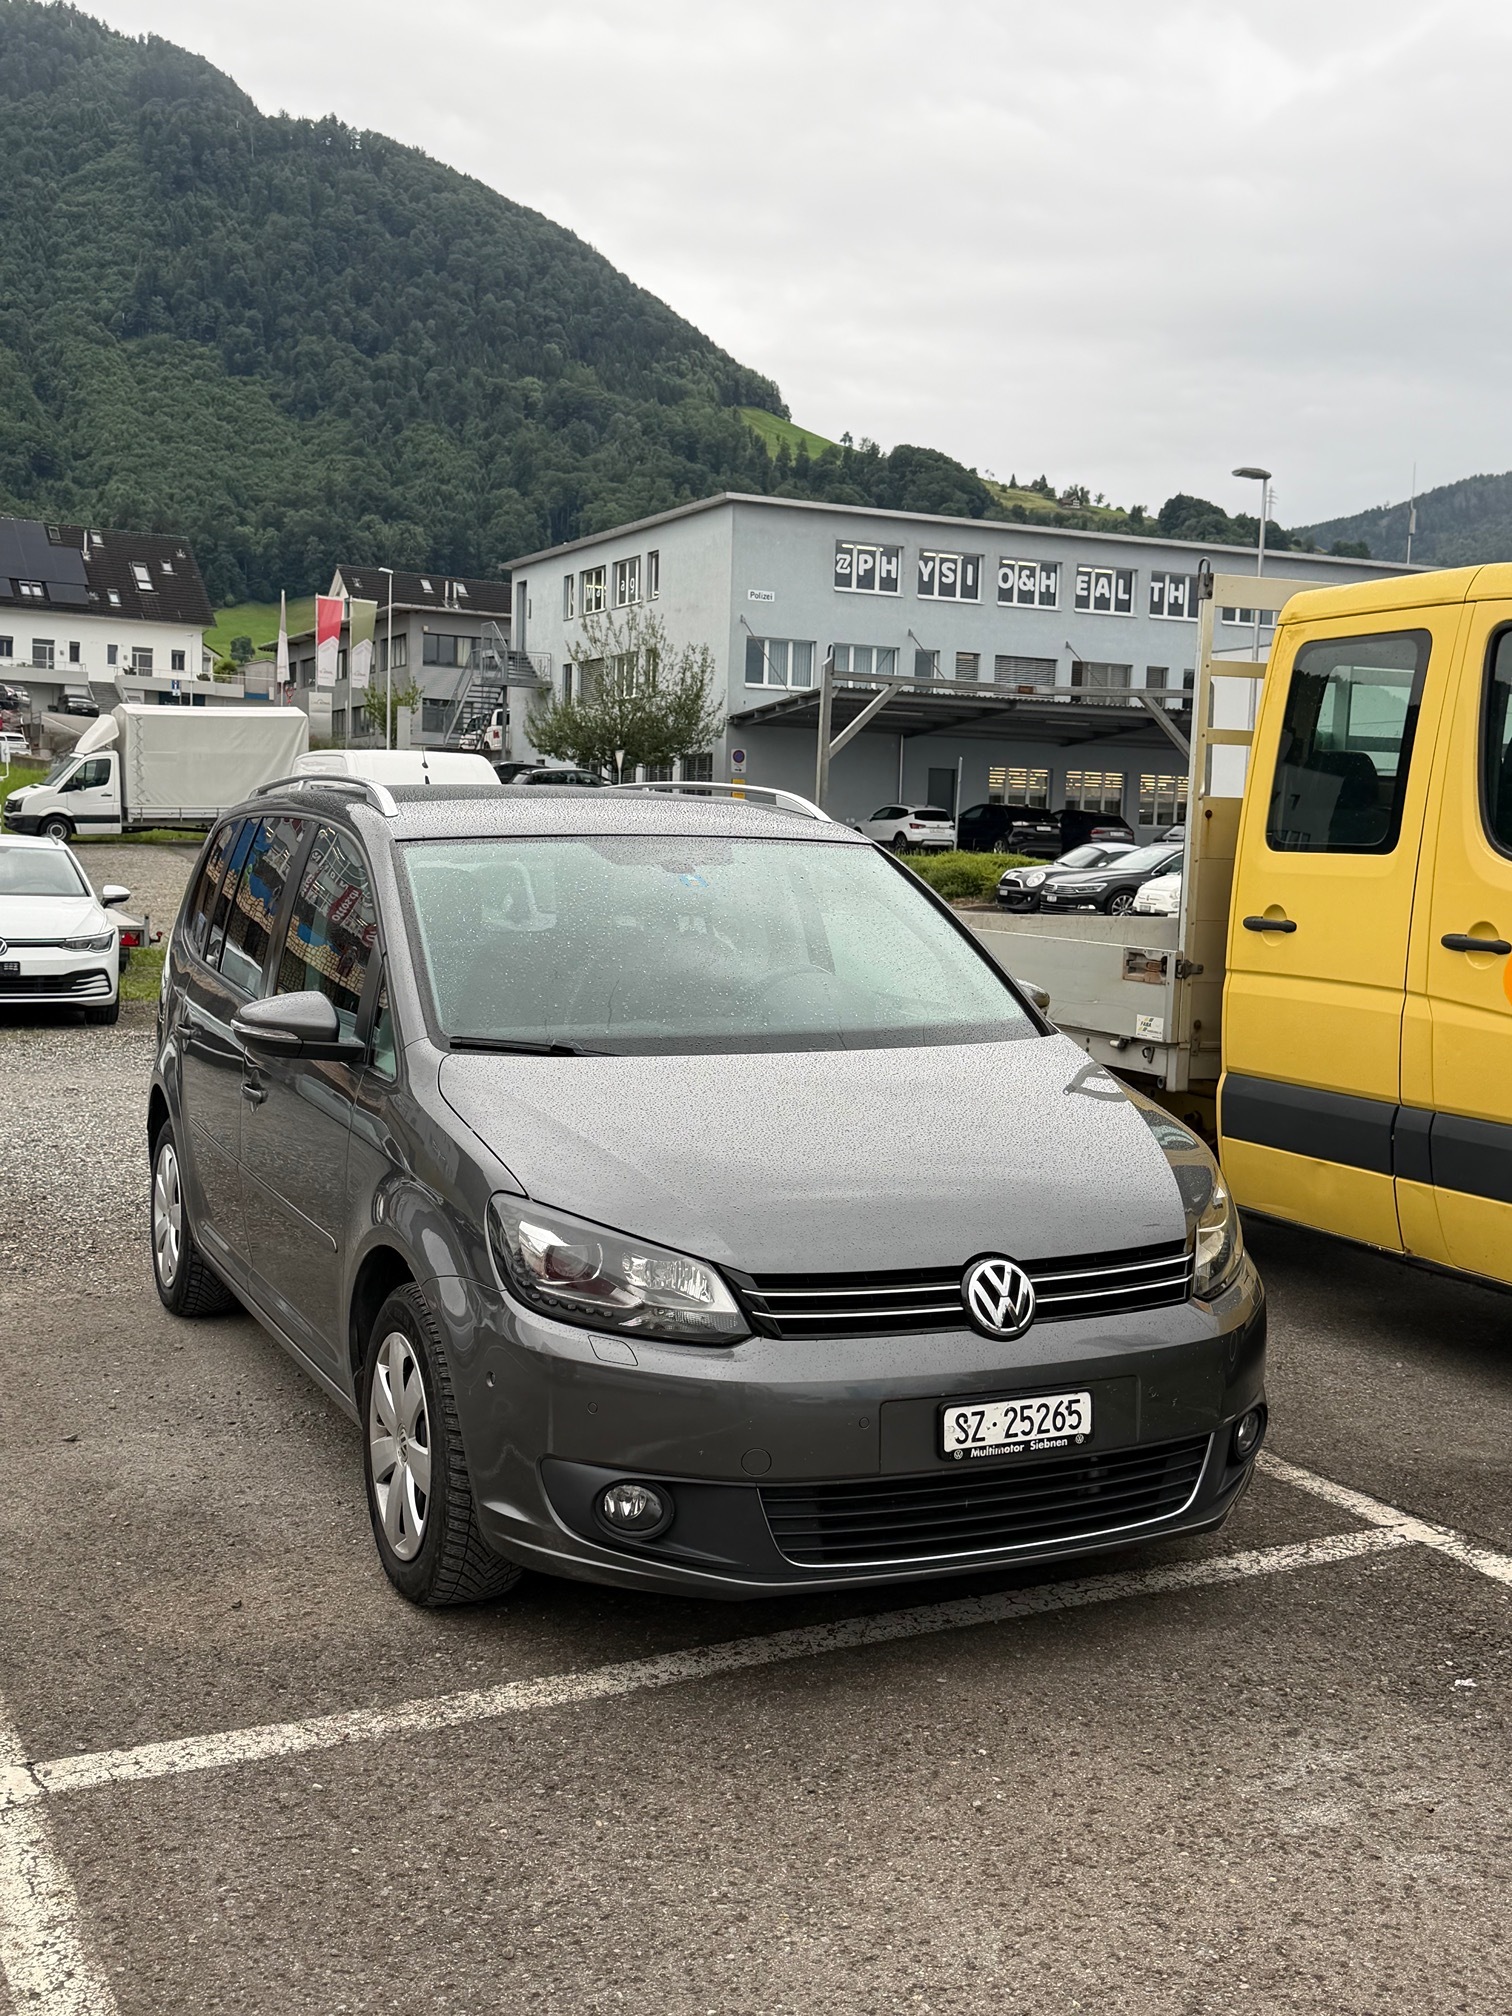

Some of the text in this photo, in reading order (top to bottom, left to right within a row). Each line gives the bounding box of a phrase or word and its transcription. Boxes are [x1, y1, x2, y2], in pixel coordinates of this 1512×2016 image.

[750, 591, 773, 600] Polizei
[970, 1444, 1025, 1458] Multimotor
[1030, 1438, 1068, 1451] Siebnen
